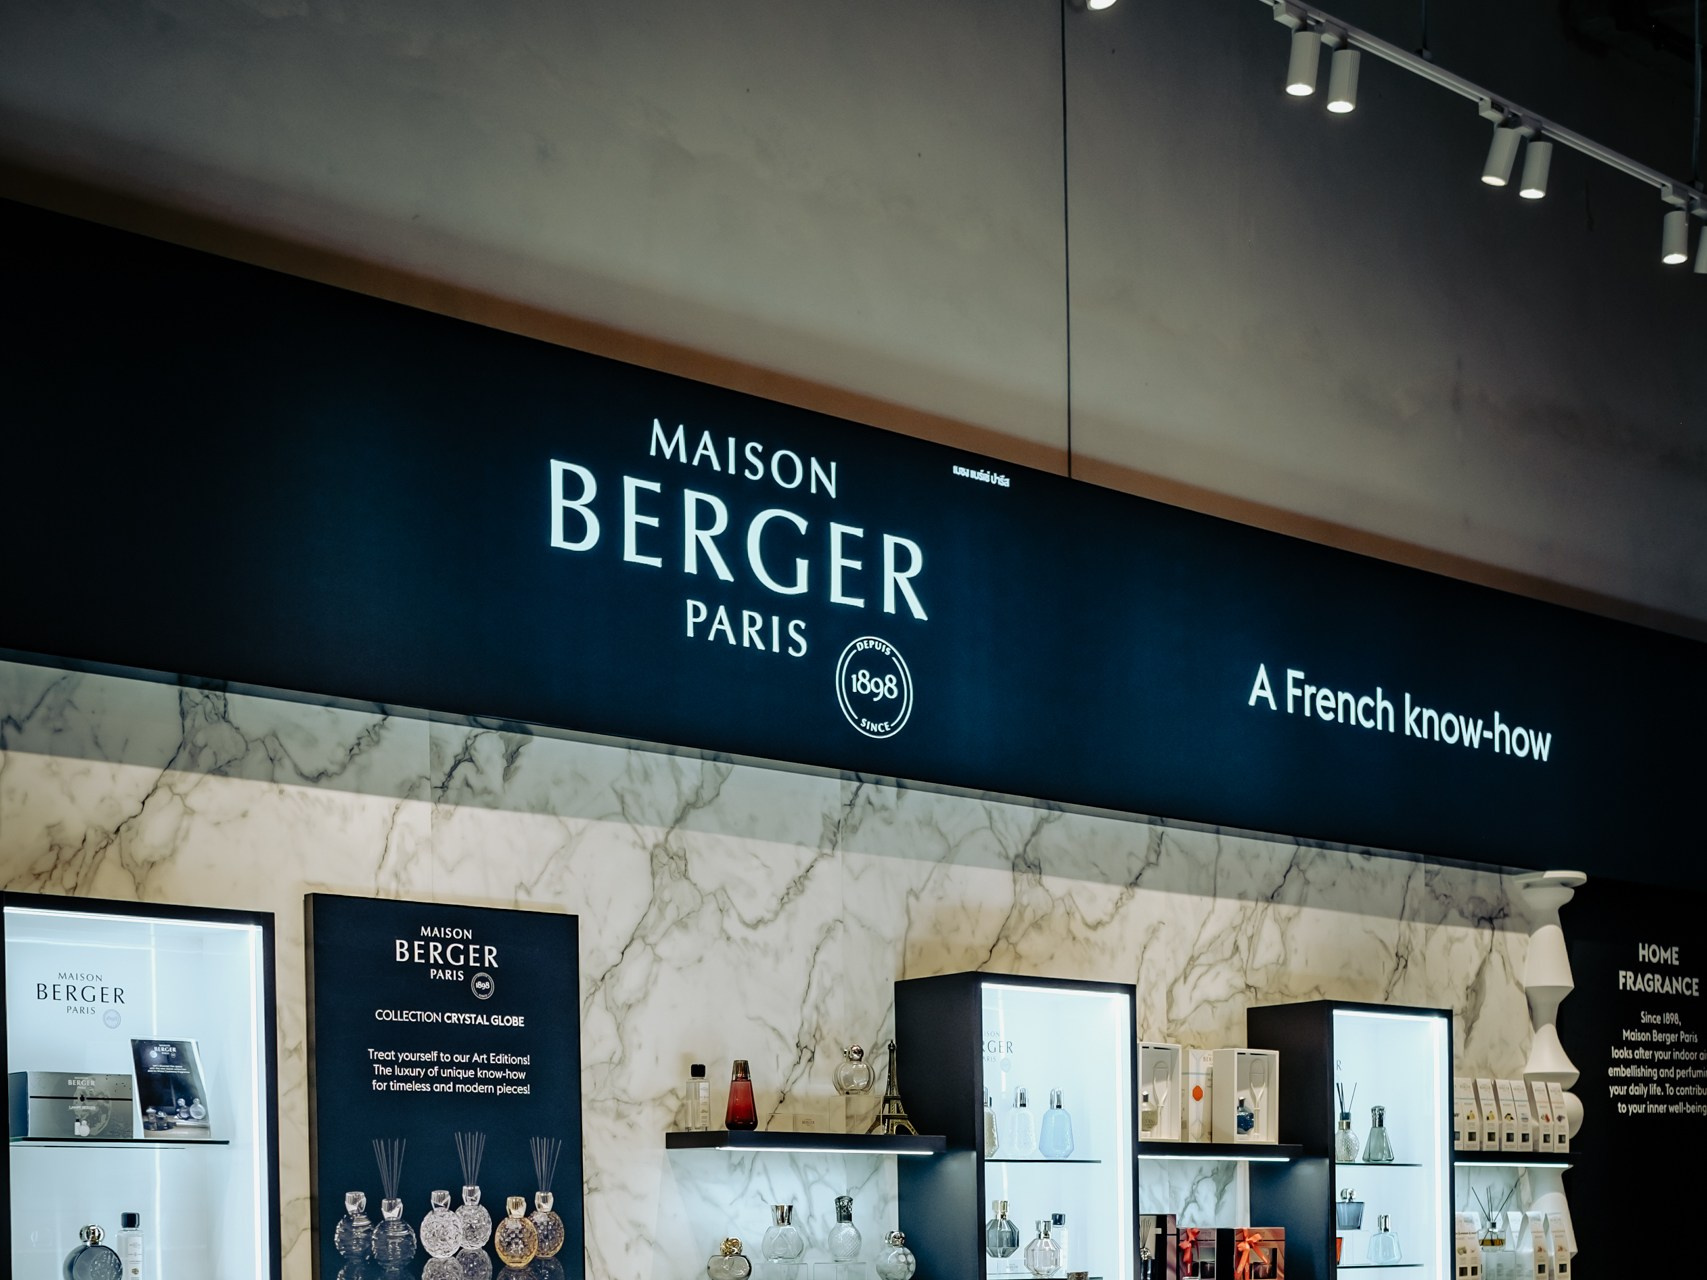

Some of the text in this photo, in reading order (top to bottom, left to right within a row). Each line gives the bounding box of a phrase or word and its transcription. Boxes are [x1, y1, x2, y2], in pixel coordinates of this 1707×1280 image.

[649, 418, 837, 498] MAISON
[550, 458, 928, 621] BERGER
[686, 599, 808, 657] PARIS
[856, 639, 891, 656] DEPUIS
[851, 669, 898, 702] 1898
[1248, 663, 1552, 762] A French know-how
[860, 718, 891, 733] SINCE
[420, 925, 473, 940] MAISON
[395, 939, 499, 968] BERGER
[1638, 942, 1680, 966] HOME
[58, 972, 103, 982] MAISON
[430, 968, 464, 981] PARIS
[1618, 969, 1700, 997] FRAGRANCE
[36, 982, 126, 1005] BERGER
[66, 1005, 96, 1015] PARIS
[375, 1009, 525, 1027] COLLECTION CRYSTAL GLOBE
[1640, 1011, 1682, 1026] Since 1898,
[1622, 1029, 1698, 1045] Maison Berger Paris
[367, 1048, 531, 1065] Treat yourself to our Art Editions!
[1611, 1046, 1633, 1059] looks
[1634, 1047, 1653, 1060] after
[1653, 1050, 1671, 1062] your
[1672, 1048, 1698, 1061] indoor
[373, 1064, 526, 1080] The luxury of unique know-how
[1607, 1065, 1658, 1081] embellishing
[1659, 1066, 1675, 1078] and
[371, 1079, 531, 1096] for timeless and modern pieces!
[1608, 1084, 1627, 1098] your
[1628, 1083, 1648, 1098] daily
[1649, 1083, 1664, 1096] life.
[1665, 1083, 1674, 1096] To
[1617, 1102, 1627, 1114] to
[1628, 1103, 1646, 1116] your
[1647, 1102, 1667, 1114] inner
